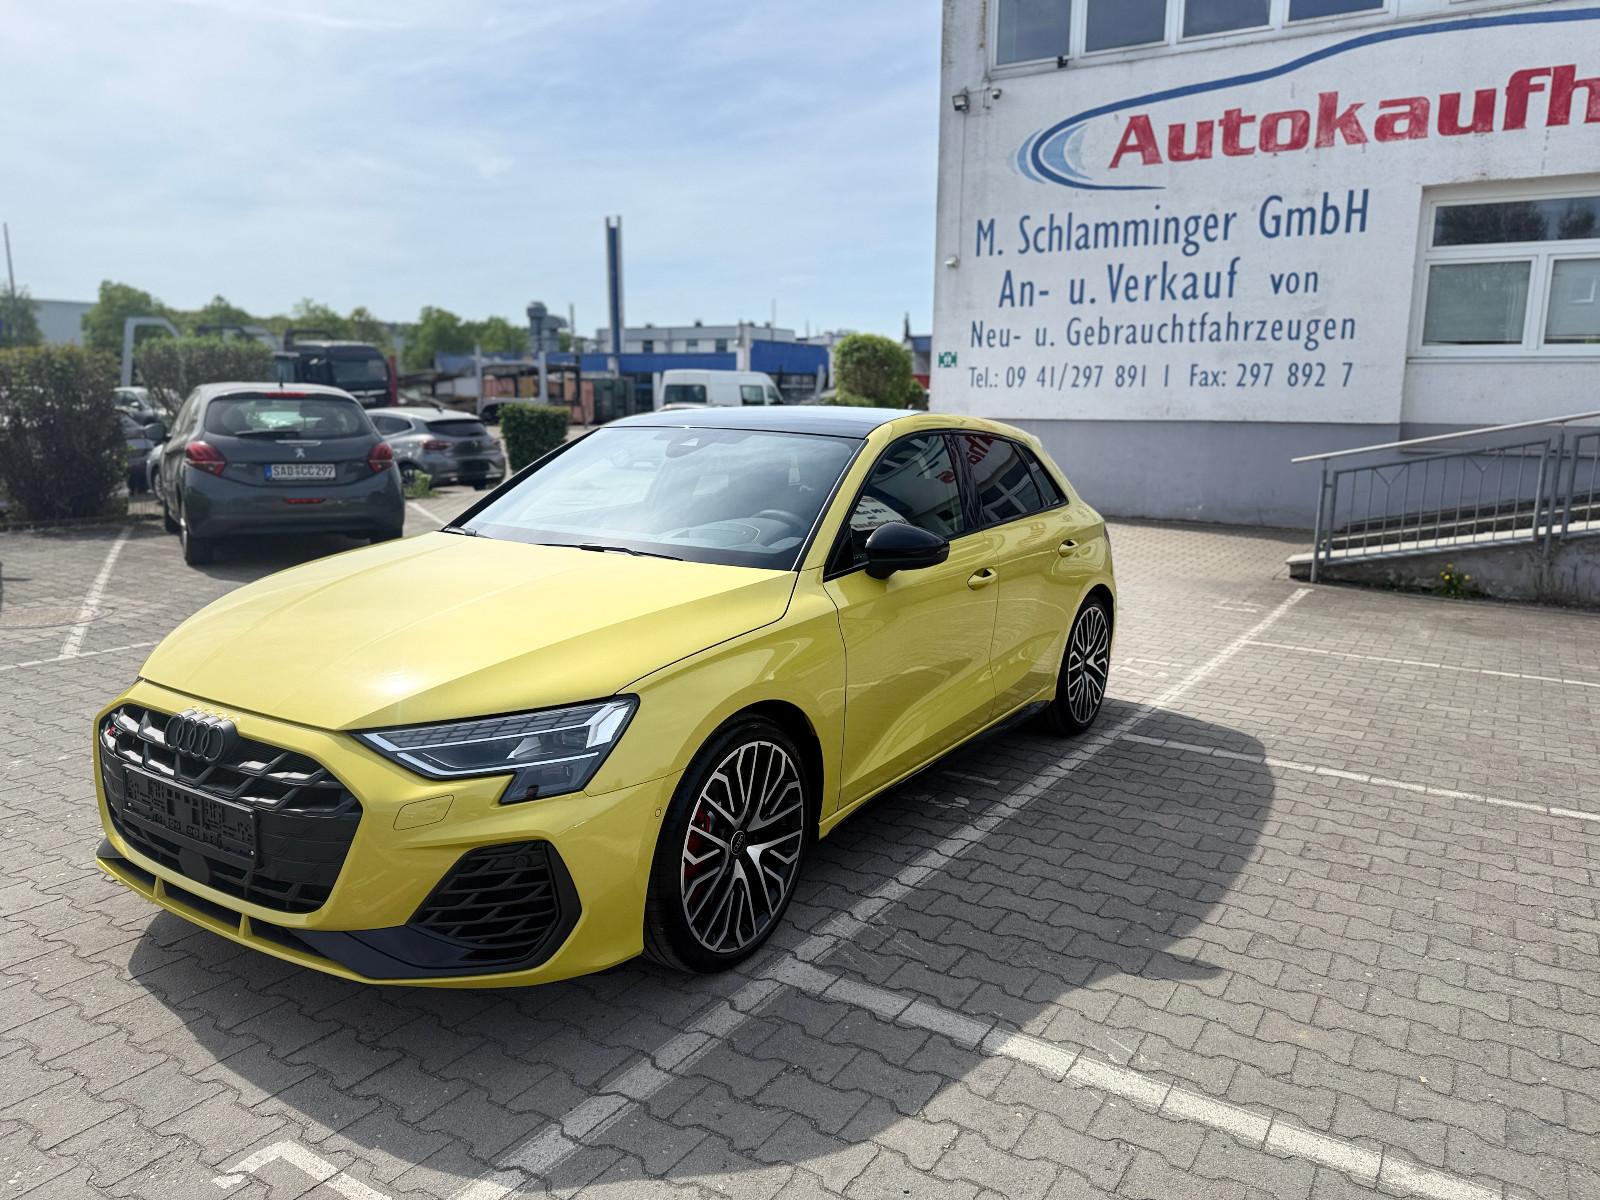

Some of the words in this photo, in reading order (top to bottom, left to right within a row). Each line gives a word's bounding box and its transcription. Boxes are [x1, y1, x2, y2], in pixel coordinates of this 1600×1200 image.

[1108, 63, 1600, 169] Autokaufh
[976, 217, 1004, 258] M.
[1018, 203, 1237, 257] Schlamminger
[1259, 188, 1370, 239] GmbH
[998, 269, 1049, 308] An-
[1069, 278, 1096, 305] u.
[1107, 256, 1241, 304] Verkauf
[1270, 271, 1319, 295] von
[970, 320, 1022, 349] Neu-
[1035, 326, 1055, 347] u.
[1066, 311, 1356, 351] Gebrauchtfahrzeugen
[968, 365, 999, 389] Tel.:
[1005, 366, 1027, 389] 09
[1036, 362, 1104, 391] 41/297
[1115, 364, 1147, 388] 891
[1189, 363, 1227, 388] Fax:
[1236, 362, 1274, 388] 297
[1287, 361, 1327, 388] 892
[1342, 361, 1354, 388] 7
